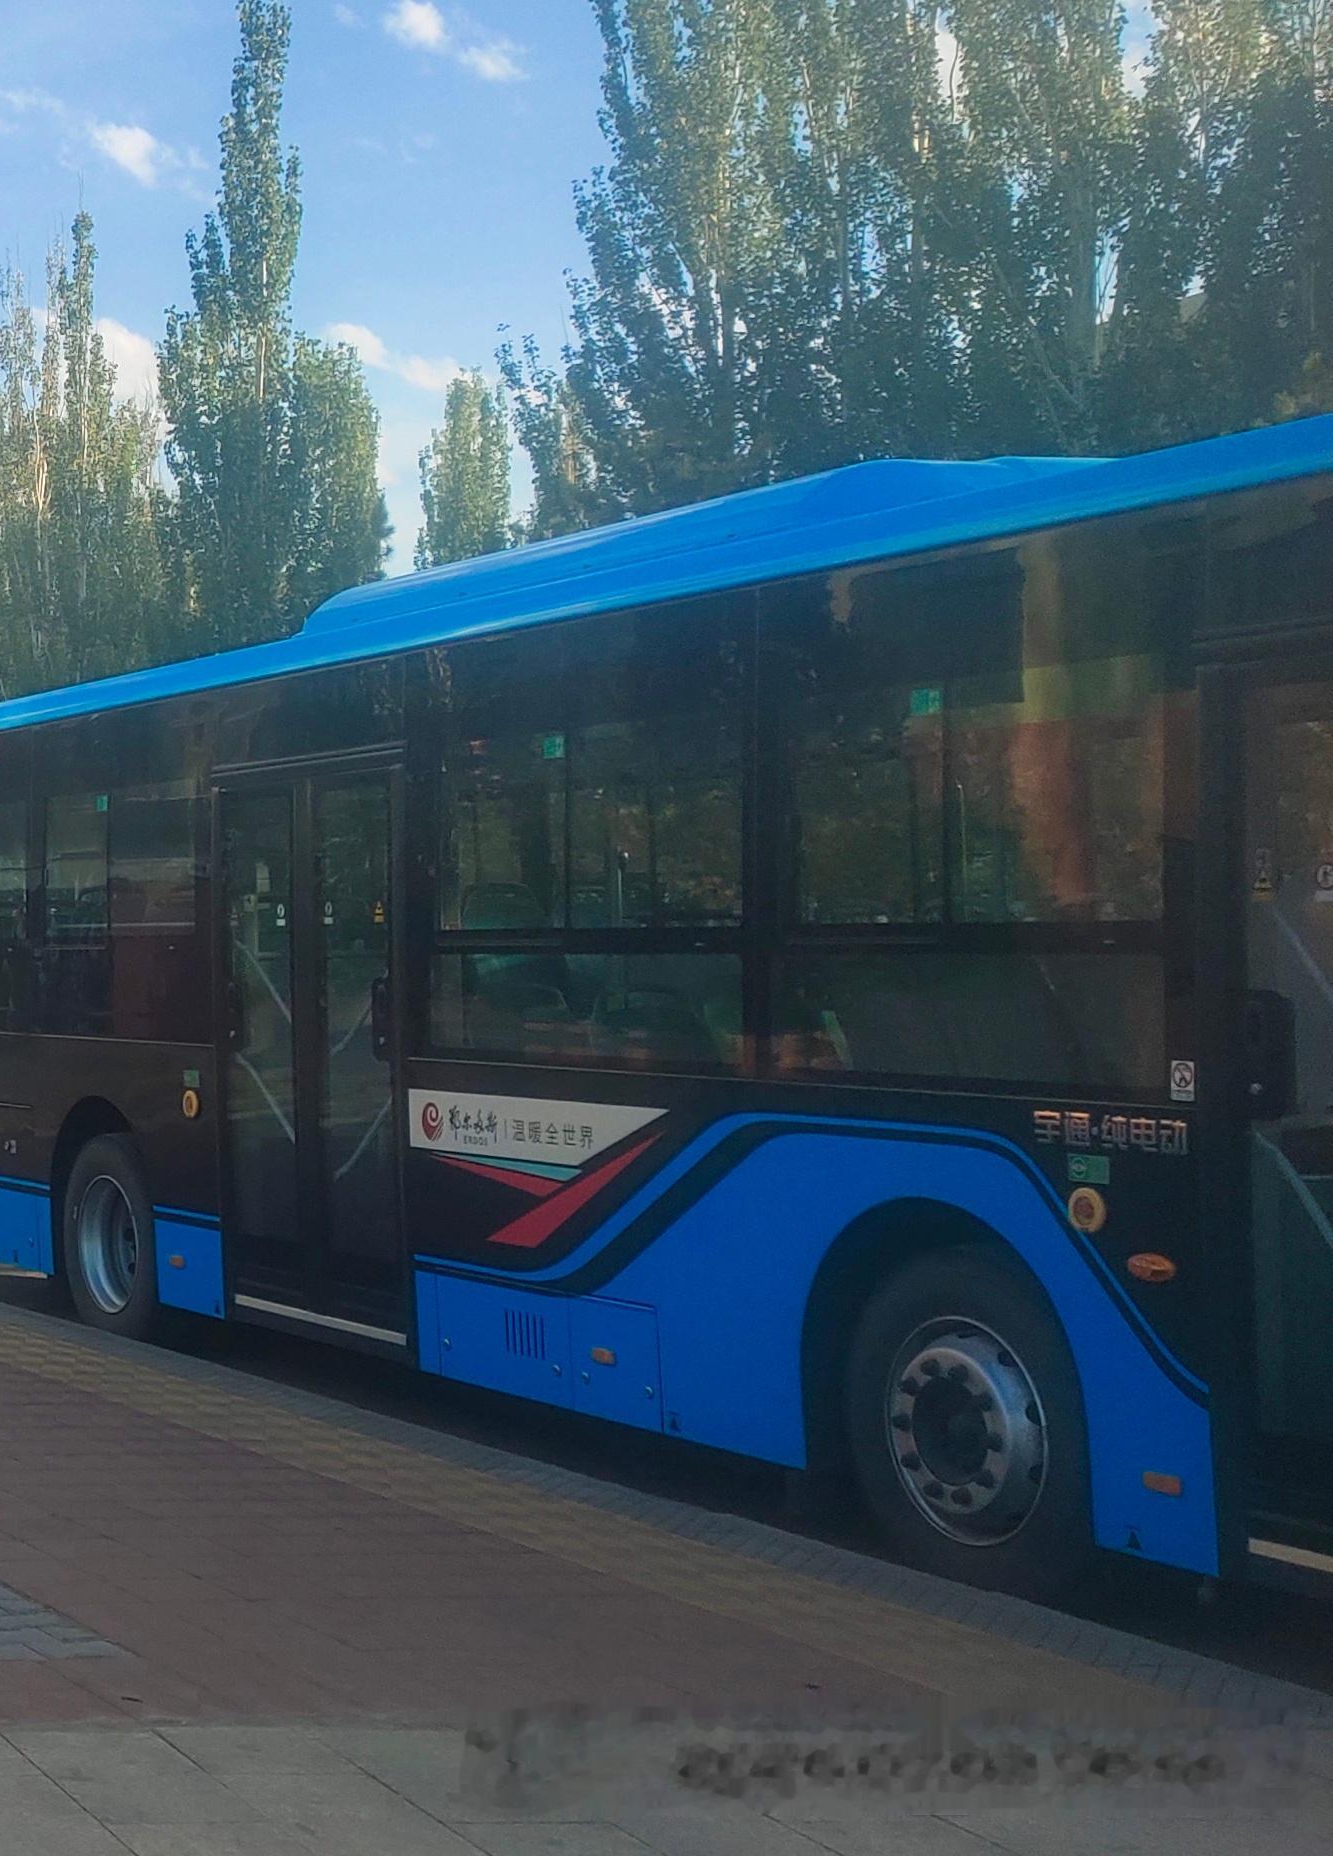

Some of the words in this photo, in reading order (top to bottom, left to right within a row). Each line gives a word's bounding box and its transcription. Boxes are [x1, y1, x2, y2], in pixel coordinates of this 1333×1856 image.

[463, 1134, 489, 1147] ERDOS
[511, 1118, 595, 1150] 温暖全世界
